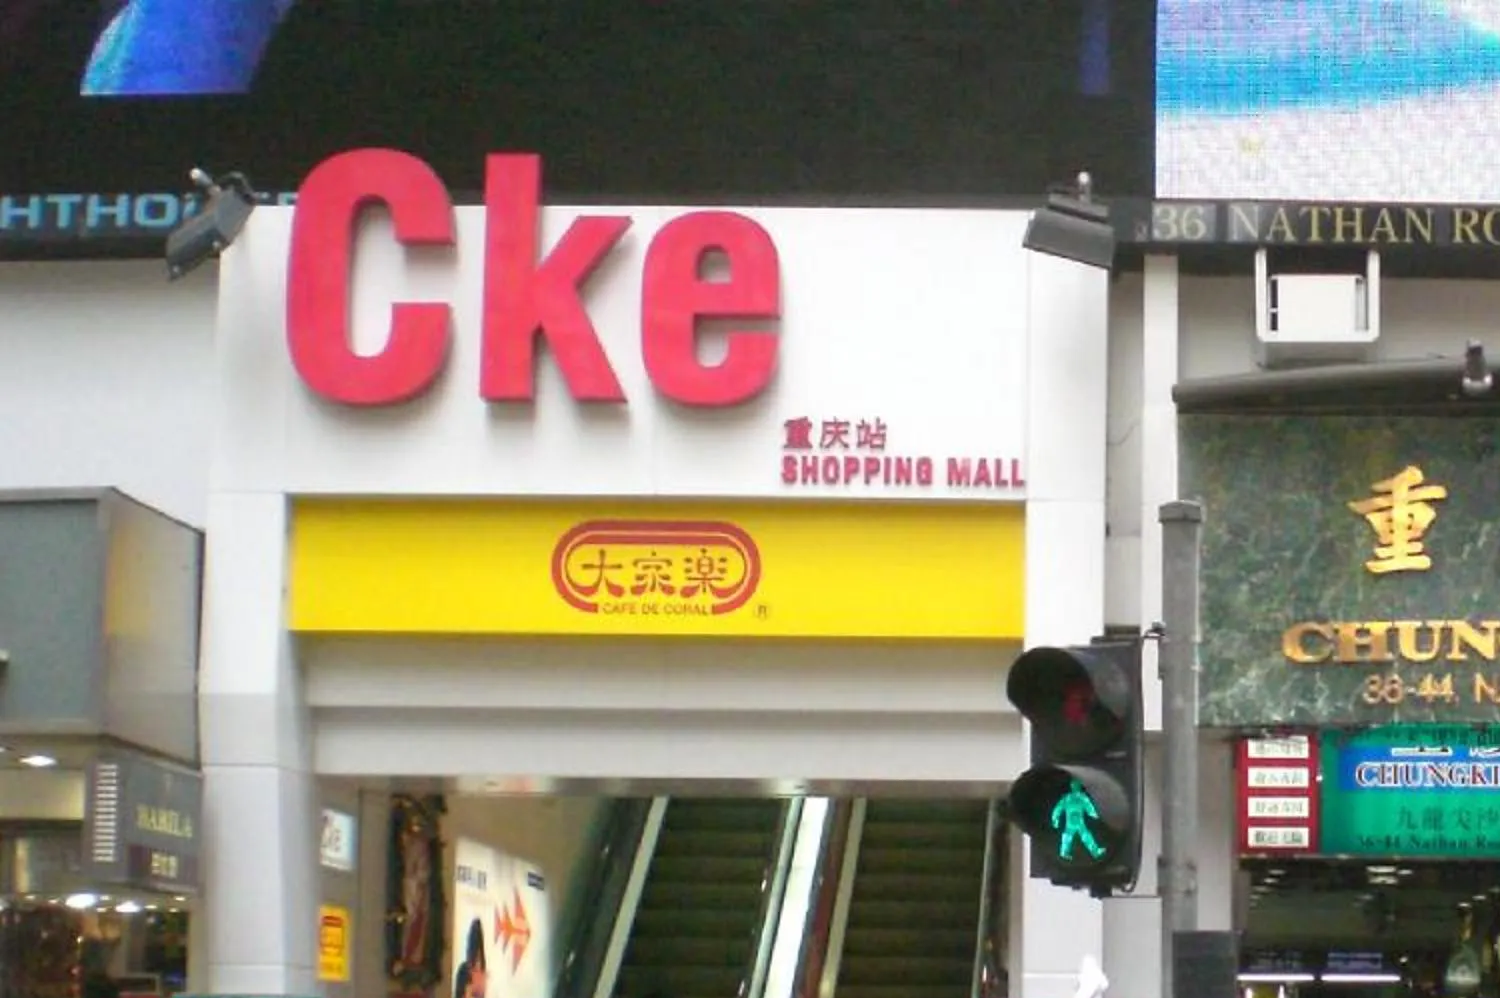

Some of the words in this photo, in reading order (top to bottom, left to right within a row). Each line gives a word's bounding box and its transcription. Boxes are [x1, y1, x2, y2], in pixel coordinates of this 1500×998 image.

[1153, 204, 1208, 241] 36
[1227, 205, 1434, 243] NATHAN
[286, 146, 785, 410] Cke
[780, 455, 934, 487] SHOPPING
[947, 457, 1026, 489] MALL
[1362, 673, 1456, 703] 36-44
